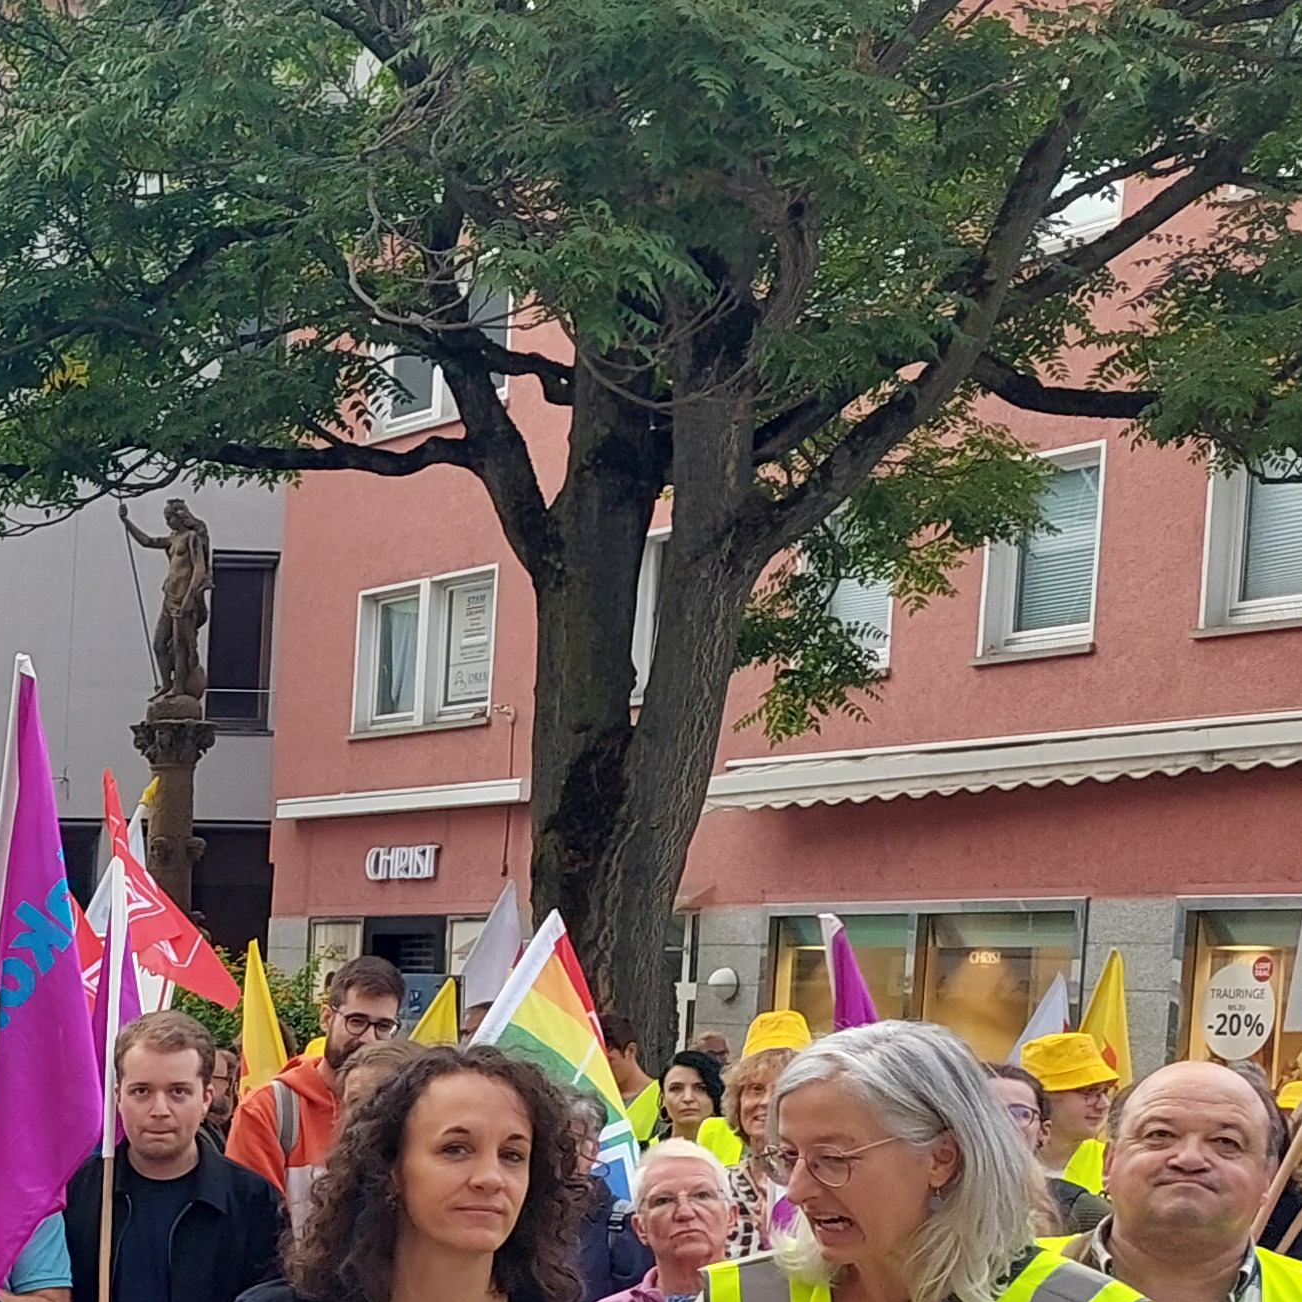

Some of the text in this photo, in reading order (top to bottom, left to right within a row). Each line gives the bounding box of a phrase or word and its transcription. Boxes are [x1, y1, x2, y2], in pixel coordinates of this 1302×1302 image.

[365, 844, 440, 881] CHRIST
[1210, 987, 1265, 999] TRAURINGE
[1207, 1013, 1265, 1037] -20%
